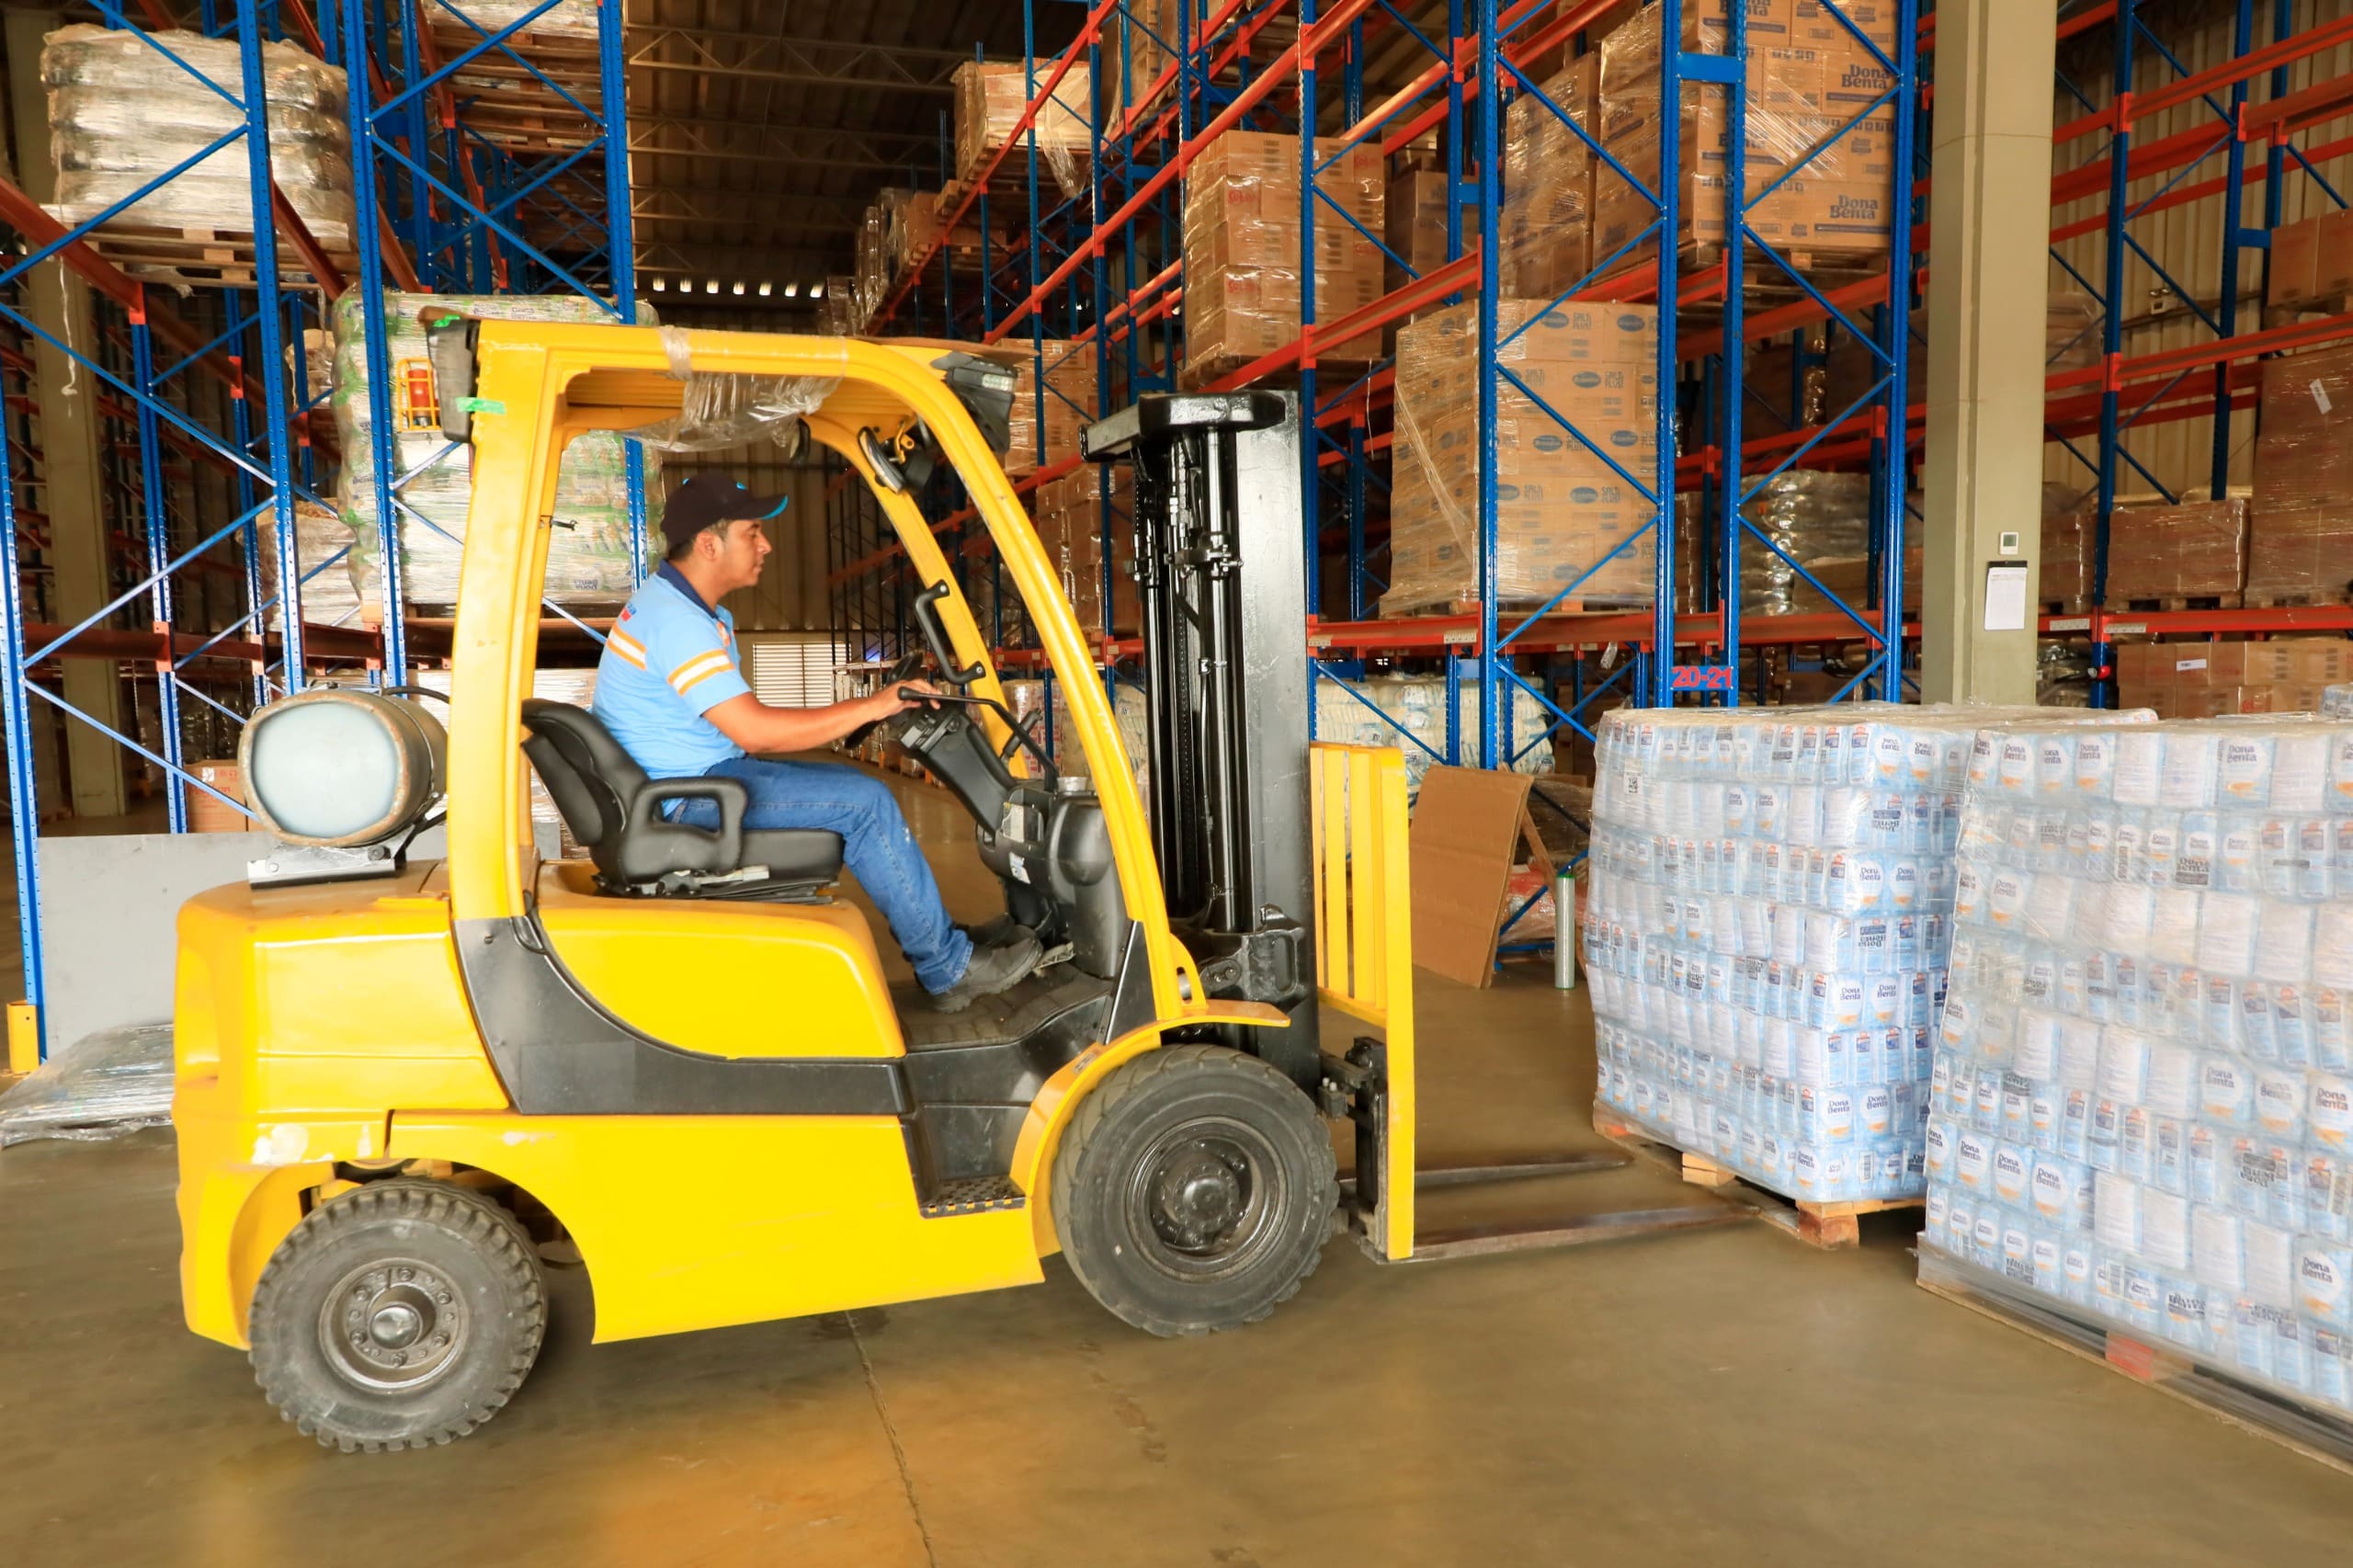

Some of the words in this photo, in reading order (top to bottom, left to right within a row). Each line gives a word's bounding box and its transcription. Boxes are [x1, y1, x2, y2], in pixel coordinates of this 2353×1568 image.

[1849, 64, 1891, 80] Dona
[1841, 74, 1887, 89] Benta
[1838, 195, 1878, 210] Dona
[1829, 205, 1876, 220] Benta
[1671, 665, 1733, 688] 20-21
[2228, 744, 2255, 754] Dona
[2226, 753, 2257, 764] Benta
[1839, 993, 1861, 1001] Benta
[1877, 990, 1896, 998] Benta
[2207, 1067, 2233, 1080] Dona
[1868, 1095, 1887, 1103] Dona
[2317, 1087, 2347, 1101] Dona
[1827, 1106, 1850, 1114] Benta
[1867, 1100, 1888, 1110] Benta
[2315, 1096, 2348, 1111] Benta
[1961, 1141, 1980, 1153] Dona
[1960, 1149, 1982, 1162] Benta
[1998, 1153, 2019, 1167] Dona
[1997, 1160, 2020, 1175] Benta
[2038, 1167, 2060, 1183] Dona
[2036, 1176, 2061, 1190] Benta
[2302, 1256, 2330, 1273] Dona
[2301, 1267, 2333, 1284] Benta
